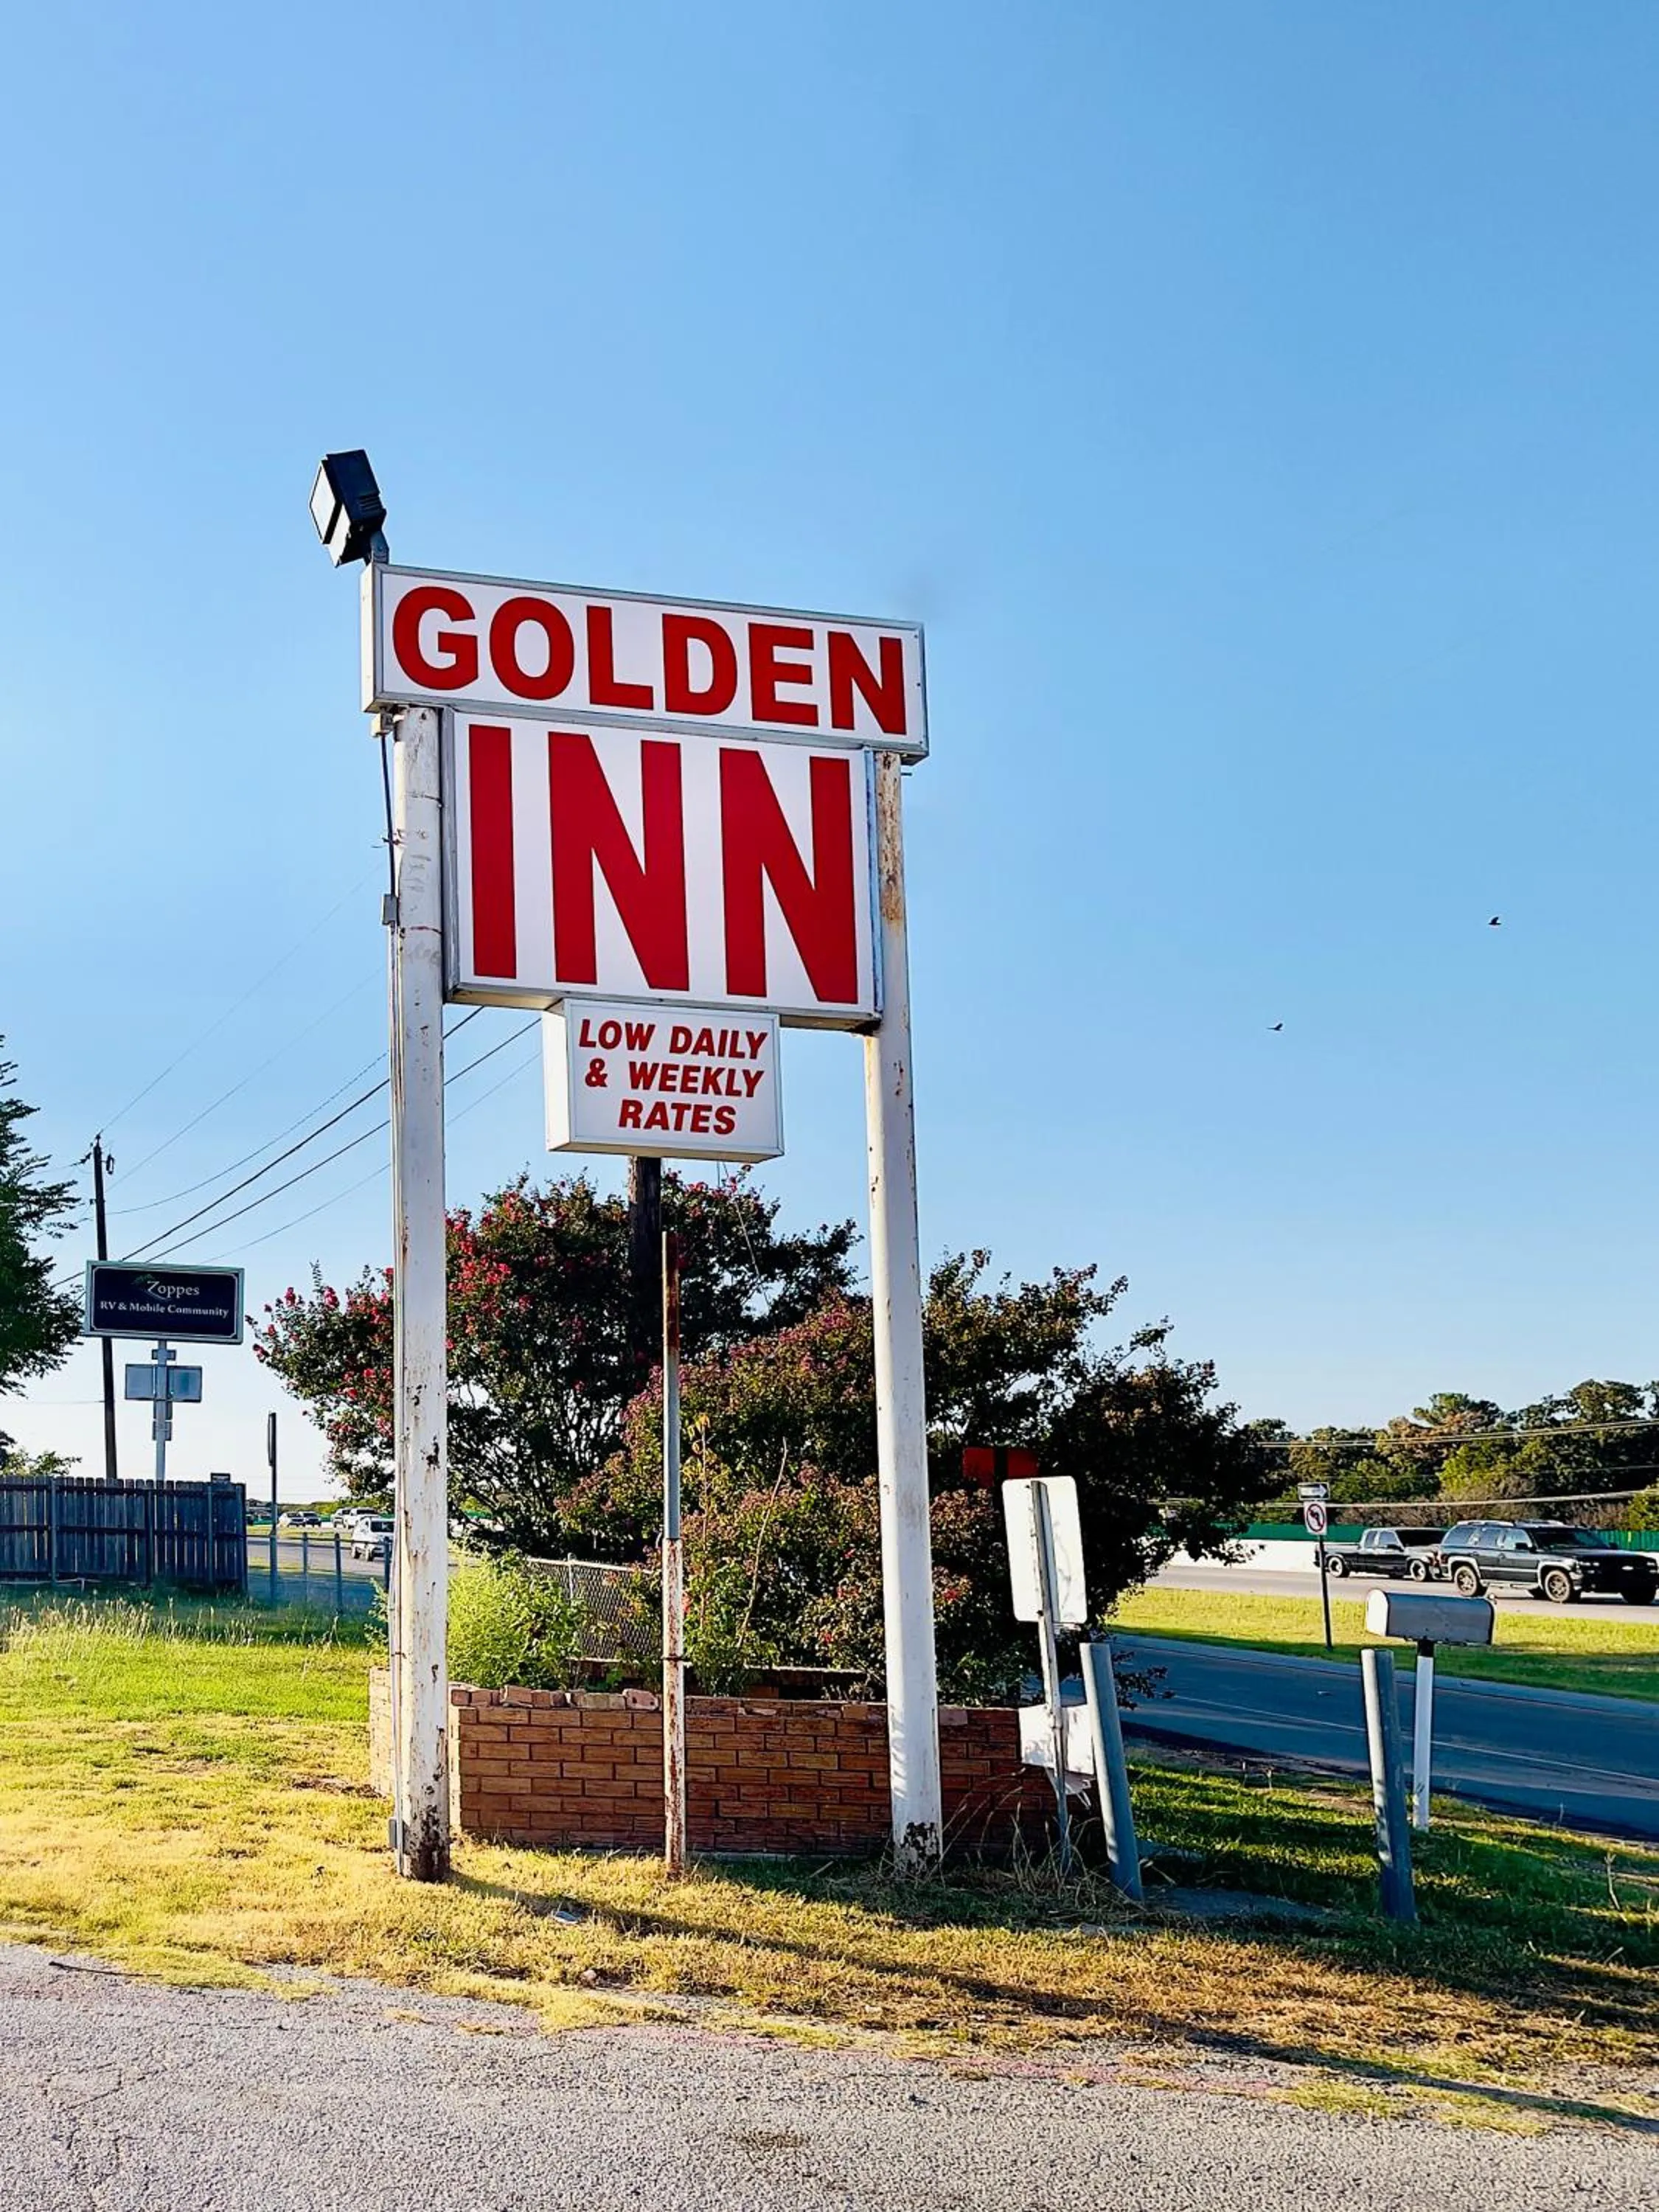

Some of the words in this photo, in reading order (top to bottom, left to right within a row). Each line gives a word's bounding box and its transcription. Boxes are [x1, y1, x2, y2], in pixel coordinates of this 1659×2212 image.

[393, 586, 906, 734] GOLDEN
[469, 725, 858, 1004] INN
[578, 1019, 655, 1051] LOW
[669, 1026, 768, 1060] DAILY
[585, 1057, 608, 1088] &
[628, 1061, 765, 1098] WEEKLY
[618, 1099, 737, 1135] RATES
[100, 1301, 117, 1310] RV
[117, 1302, 127, 1311] &
[129, 1302, 166, 1313] Mobile
[167, 1304, 229, 1318] Community
[147, 1281, 200, 1299] Zoppes
